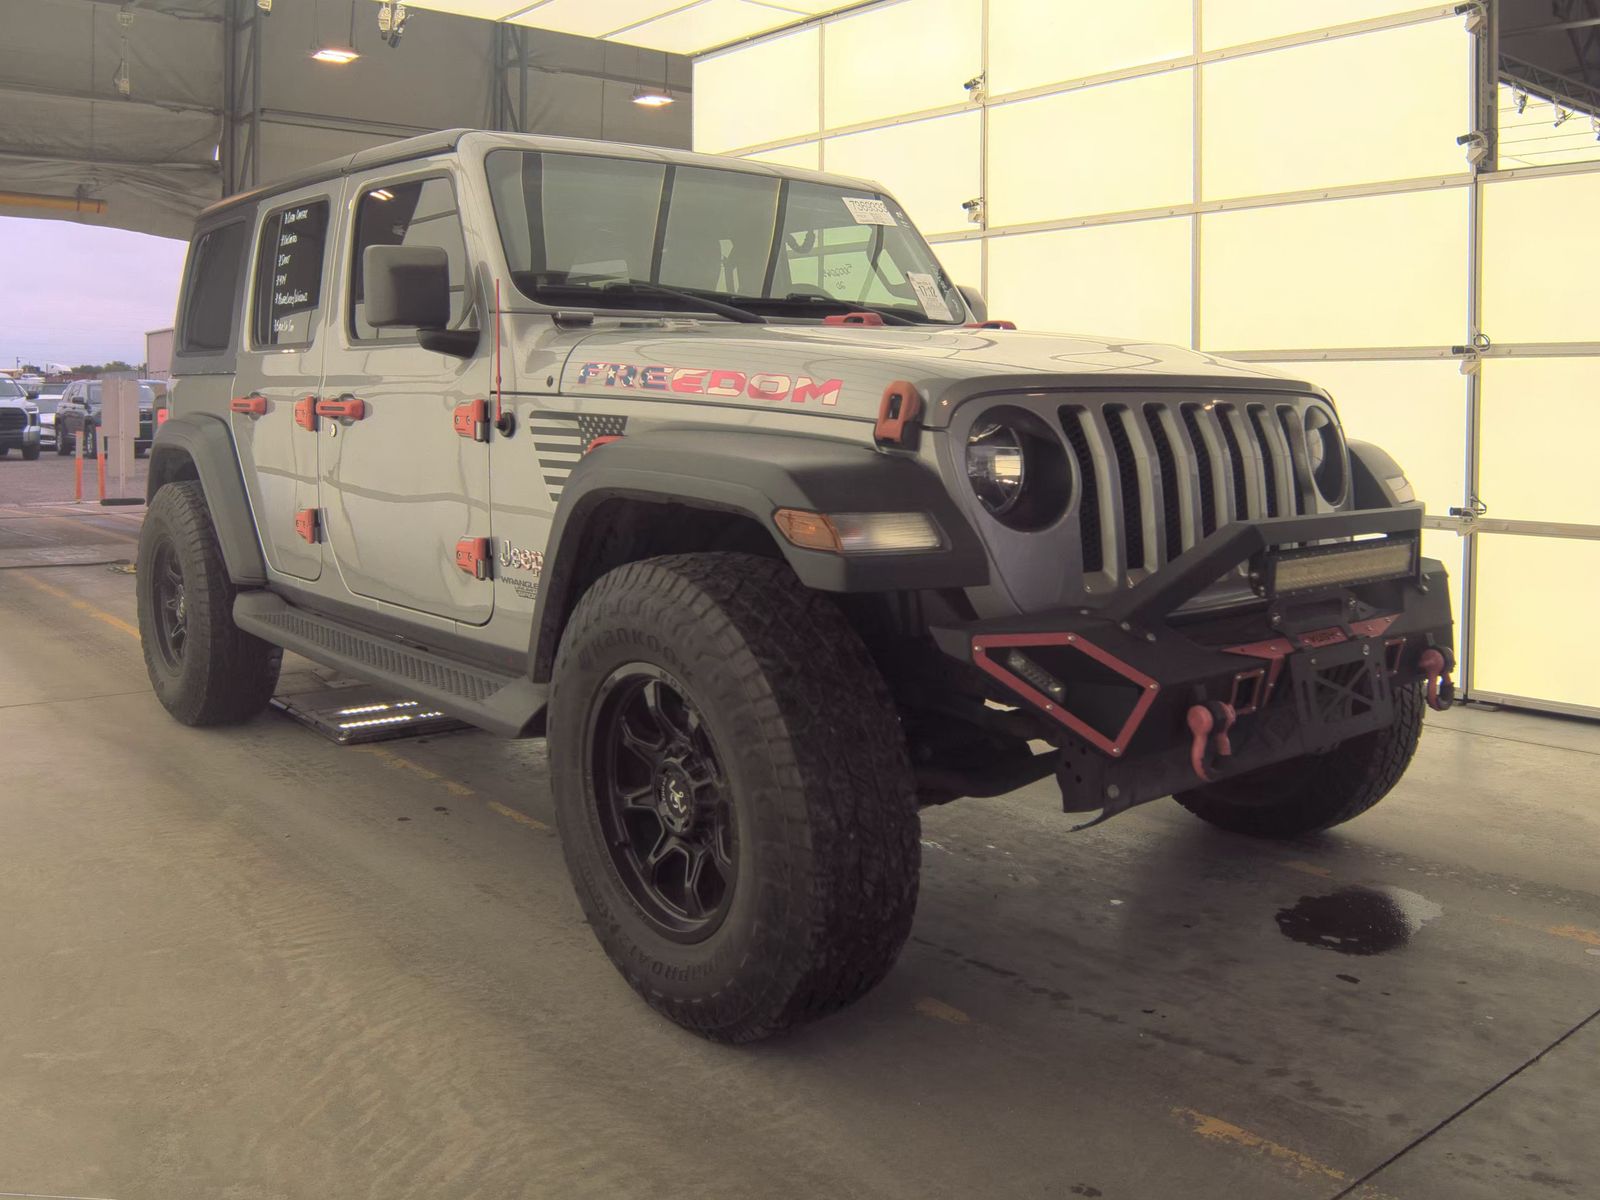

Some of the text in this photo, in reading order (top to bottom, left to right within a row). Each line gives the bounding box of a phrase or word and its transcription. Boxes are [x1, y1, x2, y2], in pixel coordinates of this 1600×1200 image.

[577, 362, 843, 406] FREEDOM
[500, 539, 544, 577] Jeep
[500, 575, 540, 589] WRANGLE
